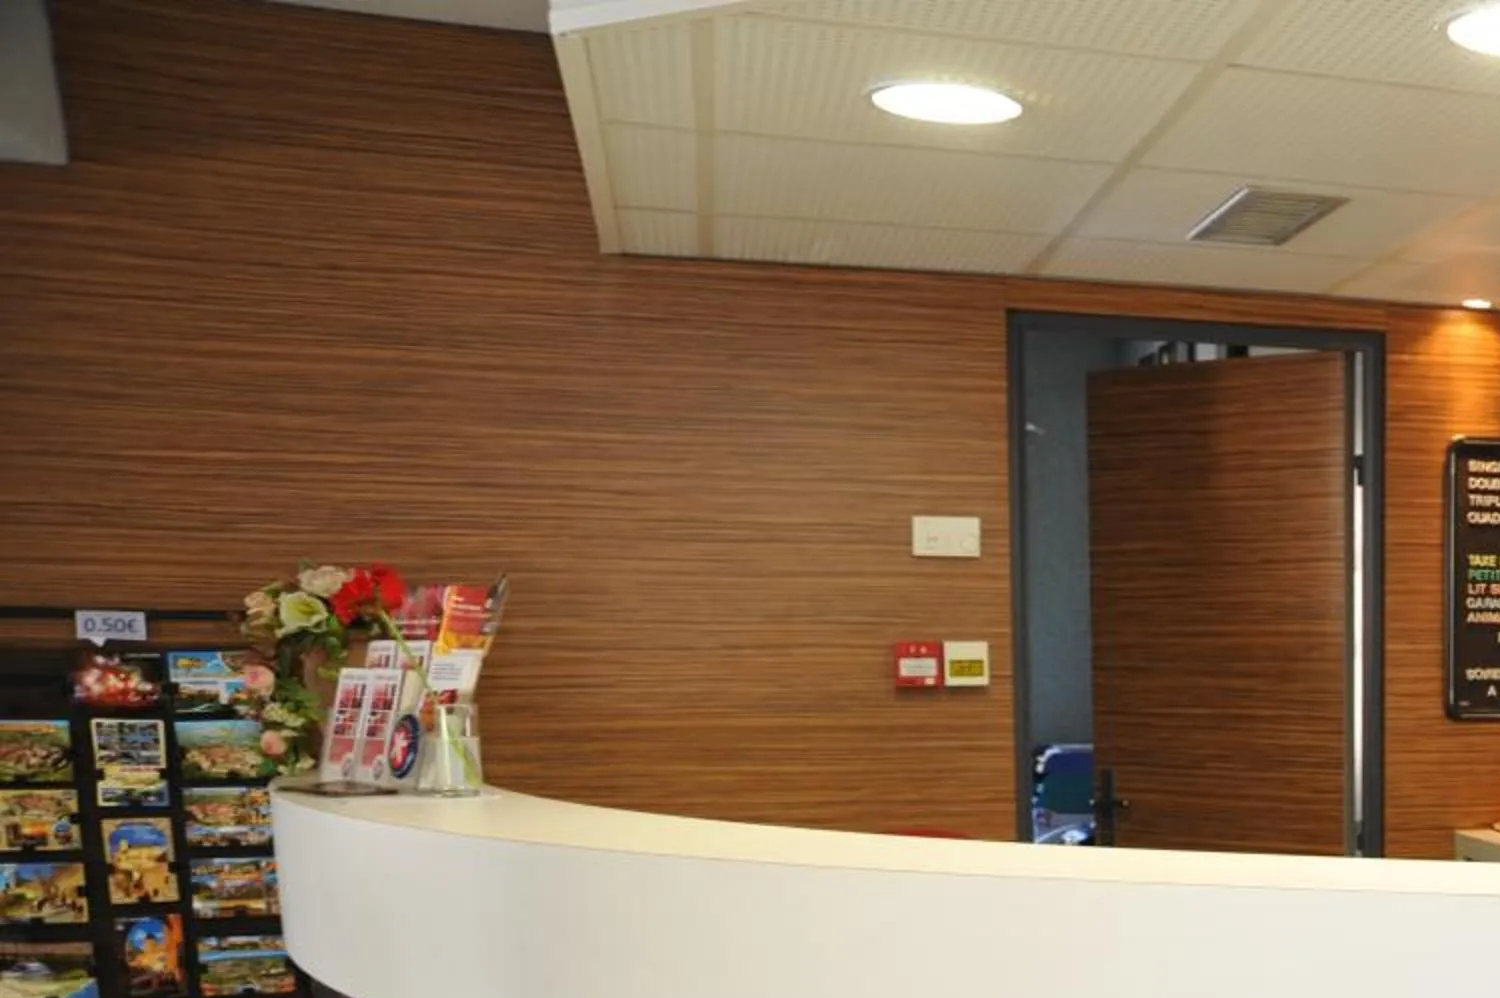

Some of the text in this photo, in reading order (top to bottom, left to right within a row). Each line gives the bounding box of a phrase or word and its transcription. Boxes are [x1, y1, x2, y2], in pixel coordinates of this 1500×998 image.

[1467, 554, 1497, 567] TAXE
[1467, 583, 1487, 596] LIT
[1487, 685, 1497, 698] A
